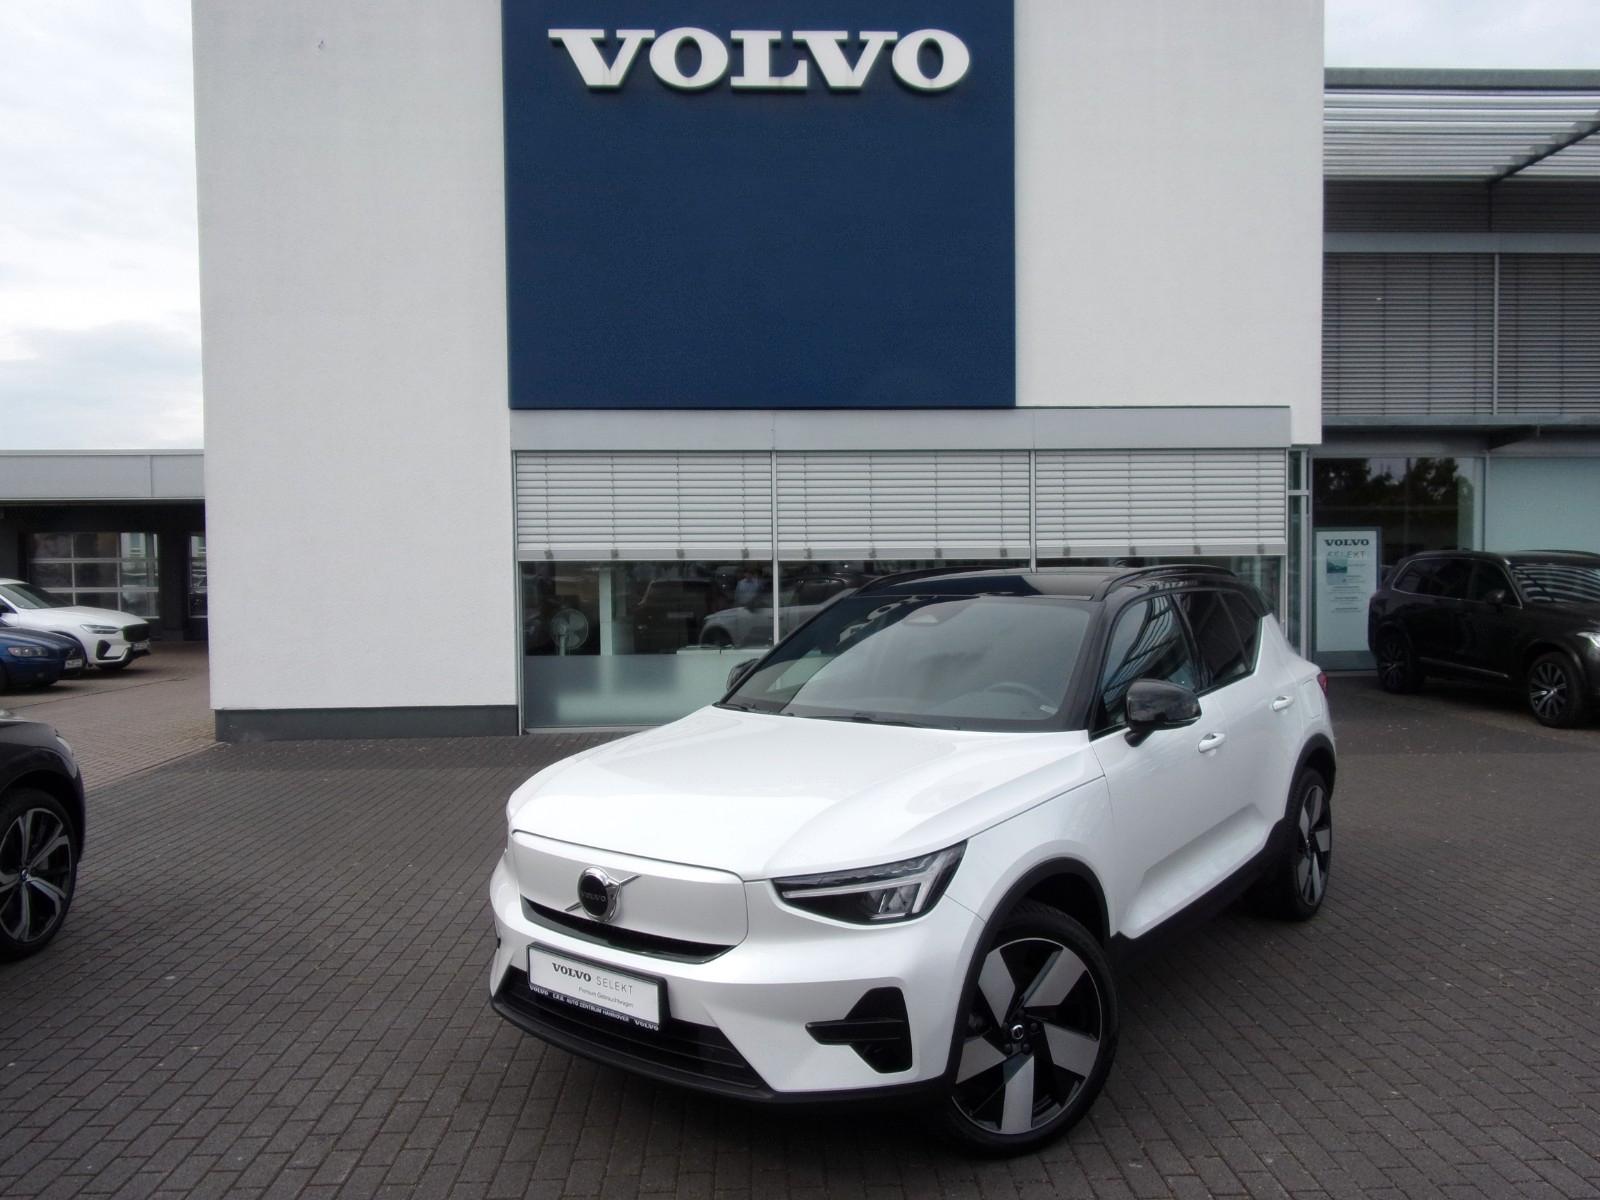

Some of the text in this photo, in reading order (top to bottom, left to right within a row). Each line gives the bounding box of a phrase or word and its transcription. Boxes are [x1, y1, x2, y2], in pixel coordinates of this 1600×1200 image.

[548, 26, 970, 91] VOLVO
[1325, 538, 1369, 546] VOLVO
[582, 891, 606, 902] VOLVO
[552, 962, 633, 995] VOLVO SELEKT
[529, 985, 549, 996] VOLVO
[634, 1019, 659, 1032] VOLVO
